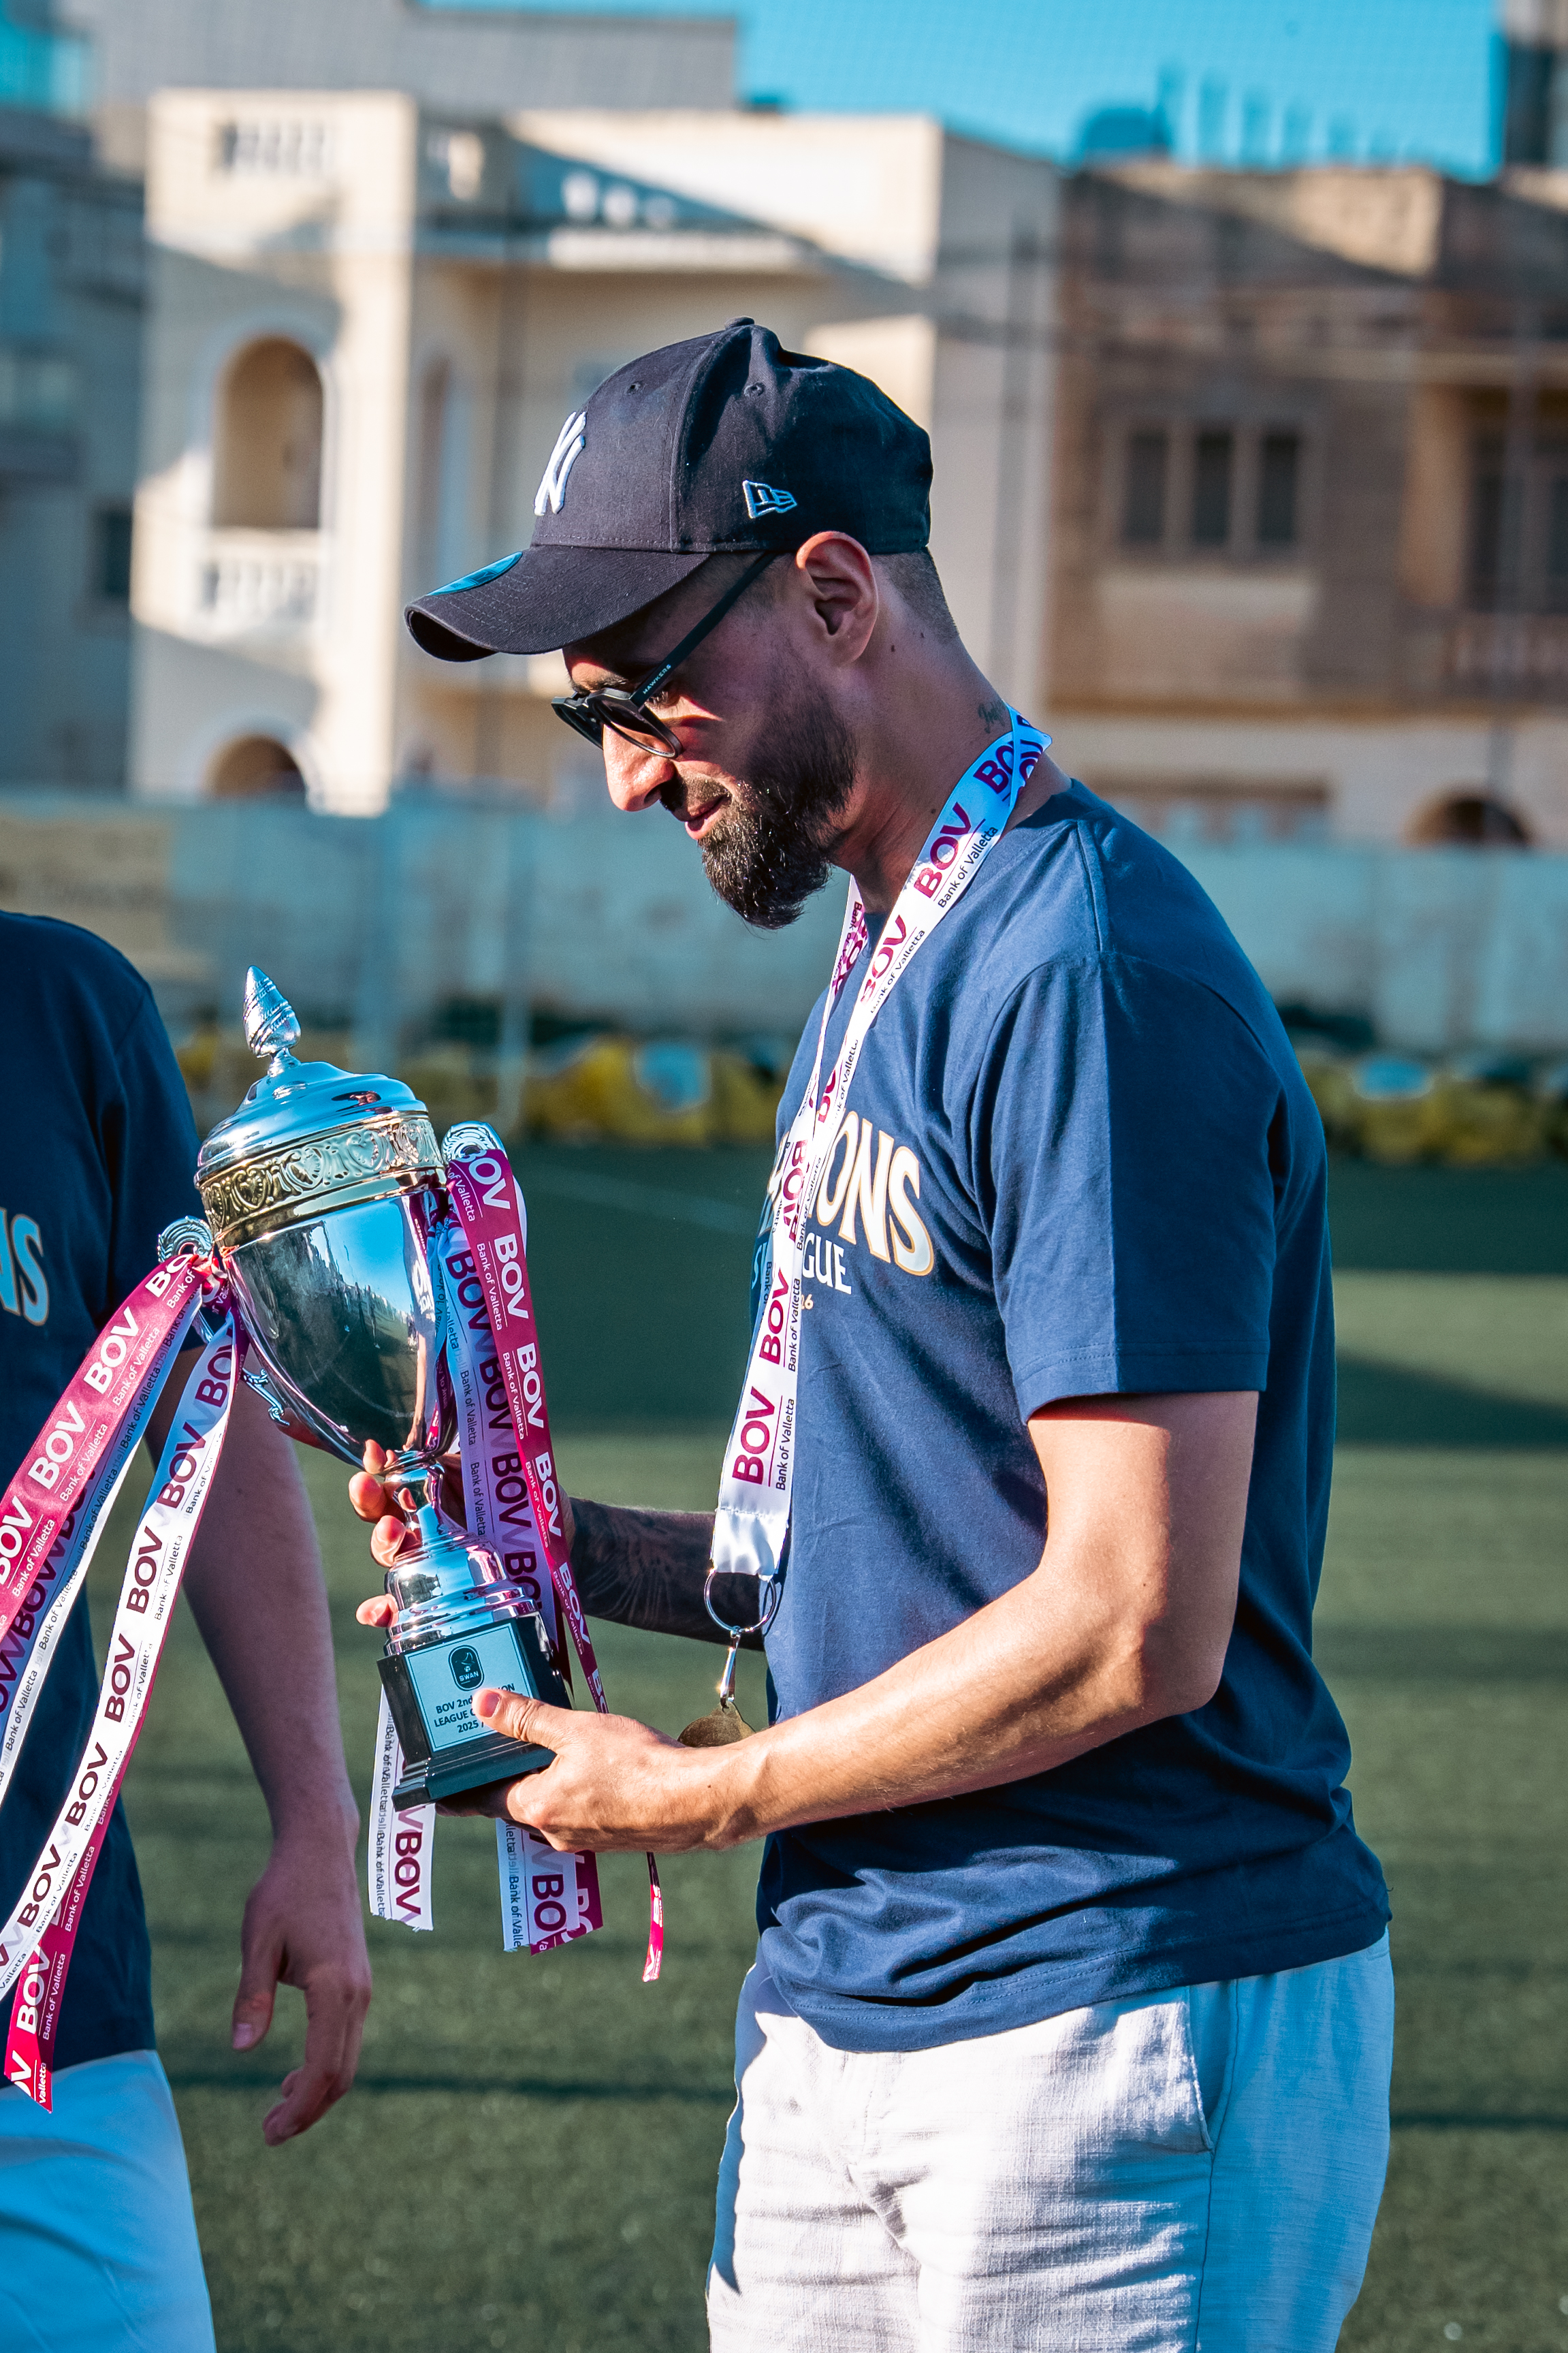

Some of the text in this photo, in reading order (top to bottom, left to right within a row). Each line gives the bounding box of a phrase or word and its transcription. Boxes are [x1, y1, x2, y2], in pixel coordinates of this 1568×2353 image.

[642, 664, 672, 695] HAWKERS
[973, 740, 1014, 795] BO
[913, 802, 972, 898] BOV
[938, 826, 999, 909] Bank of Valletta
[860, 914, 907, 1005] BOV
[887, 973, 896, 985] of
[895, 930, 925, 970] Valletta
[455, 1179, 476, 1222] Valletta
[817, 1111, 935, 1277] ONS
[145, 1254, 193, 1298] BO
[494, 1233, 529, 1319] BOV
[797, 1222, 806, 1250] Bank
[803, 1232, 852, 1295] GUE
[167, 1282, 188, 1309] Bank
[185, 1269, 196, 1284] of
[477, 1243, 503, 1331] Bank of Valletta
[758, 1266, 789, 1365] BOV
[788, 1278, 801, 1372] Bank of Valletta
[83, 1306, 140, 1394] BOV
[112, 1327, 160, 1406] Bank of Valletta
[195, 1344, 231, 1408] BO
[517, 1342, 544, 1429] BOV
[120, 1366, 161, 1449] Bank of Valletta
[460, 1370, 476, 1446] Bank of Valletta
[502, 1352, 524, 1440] Bank of Valletta
[732, 1386, 775, 1485] BOV
[27, 1400, 86, 1489] BOV
[59, 1475, 80, 1502] Bank
[77, 1460, 87, 1476] of
[83, 1423, 108, 1462] Valletta
[157, 1422, 207, 1509] BOV
[775, 1397, 795, 1491] Bank of Valletta
[80, 1468, 118, 1549] Bank of Valletta
[185, 1489, 203, 1514] Bank
[470, 1462, 486, 1536] Bank of Valletta
[492, 1452, 532, 1528] BOV
[526, 1462, 549, 1549] Bank of Valletta
[535, 1451, 562, 1537] BOV
[0, 1496, 33, 1585] OV
[12, 1519, 55, 1597] Bank of Valletta
[126, 1526, 163, 1614] BOV
[155, 1593, 167, 1620] Bank
[167, 1535, 183, 1577] Valletta
[505, 1551, 543, 1609] BO
[39, 1624, 54, 1651] Bank
[50, 1608, 59, 1623] of
[559, 1562, 590, 1645] BOV
[15, 1708, 22, 1724] of
[18, 1670, 37, 1711] Valletta
[104, 1633, 135, 1723] BOV
[137, 1689, 144, 1700] of
[436, 1701, 455, 1714] BOV
[456, 1695, 473, 1707] 2nd
[459, 1671, 479, 1682] SWAN
[5, 1724, 19, 1751] Bank
[434, 1710, 469, 1728] LEAGUE
[457, 1720, 479, 1733] 2025
[65, 1741, 108, 1827] BOV
[101, 1750, 123, 1790] Valletta
[17, 1844, 61, 1928] BOV
[35, 1907, 52, 1933] Bank
[50, 1893, 58, 1907] of
[57, 1852, 78, 1892] Valletta
[65, 1845, 95, 1932] Bank of Valletta
[395, 1832, 422, 1915] BOV
[509, 1876, 524, 1947] Bank of Valle
[532, 1874, 567, 1932] BO
[16, 1944, 50, 2035] BOV
[42, 1953, 66, 2040] Bank of Valletta
[39, 2062, 47, 2104] Valletta
